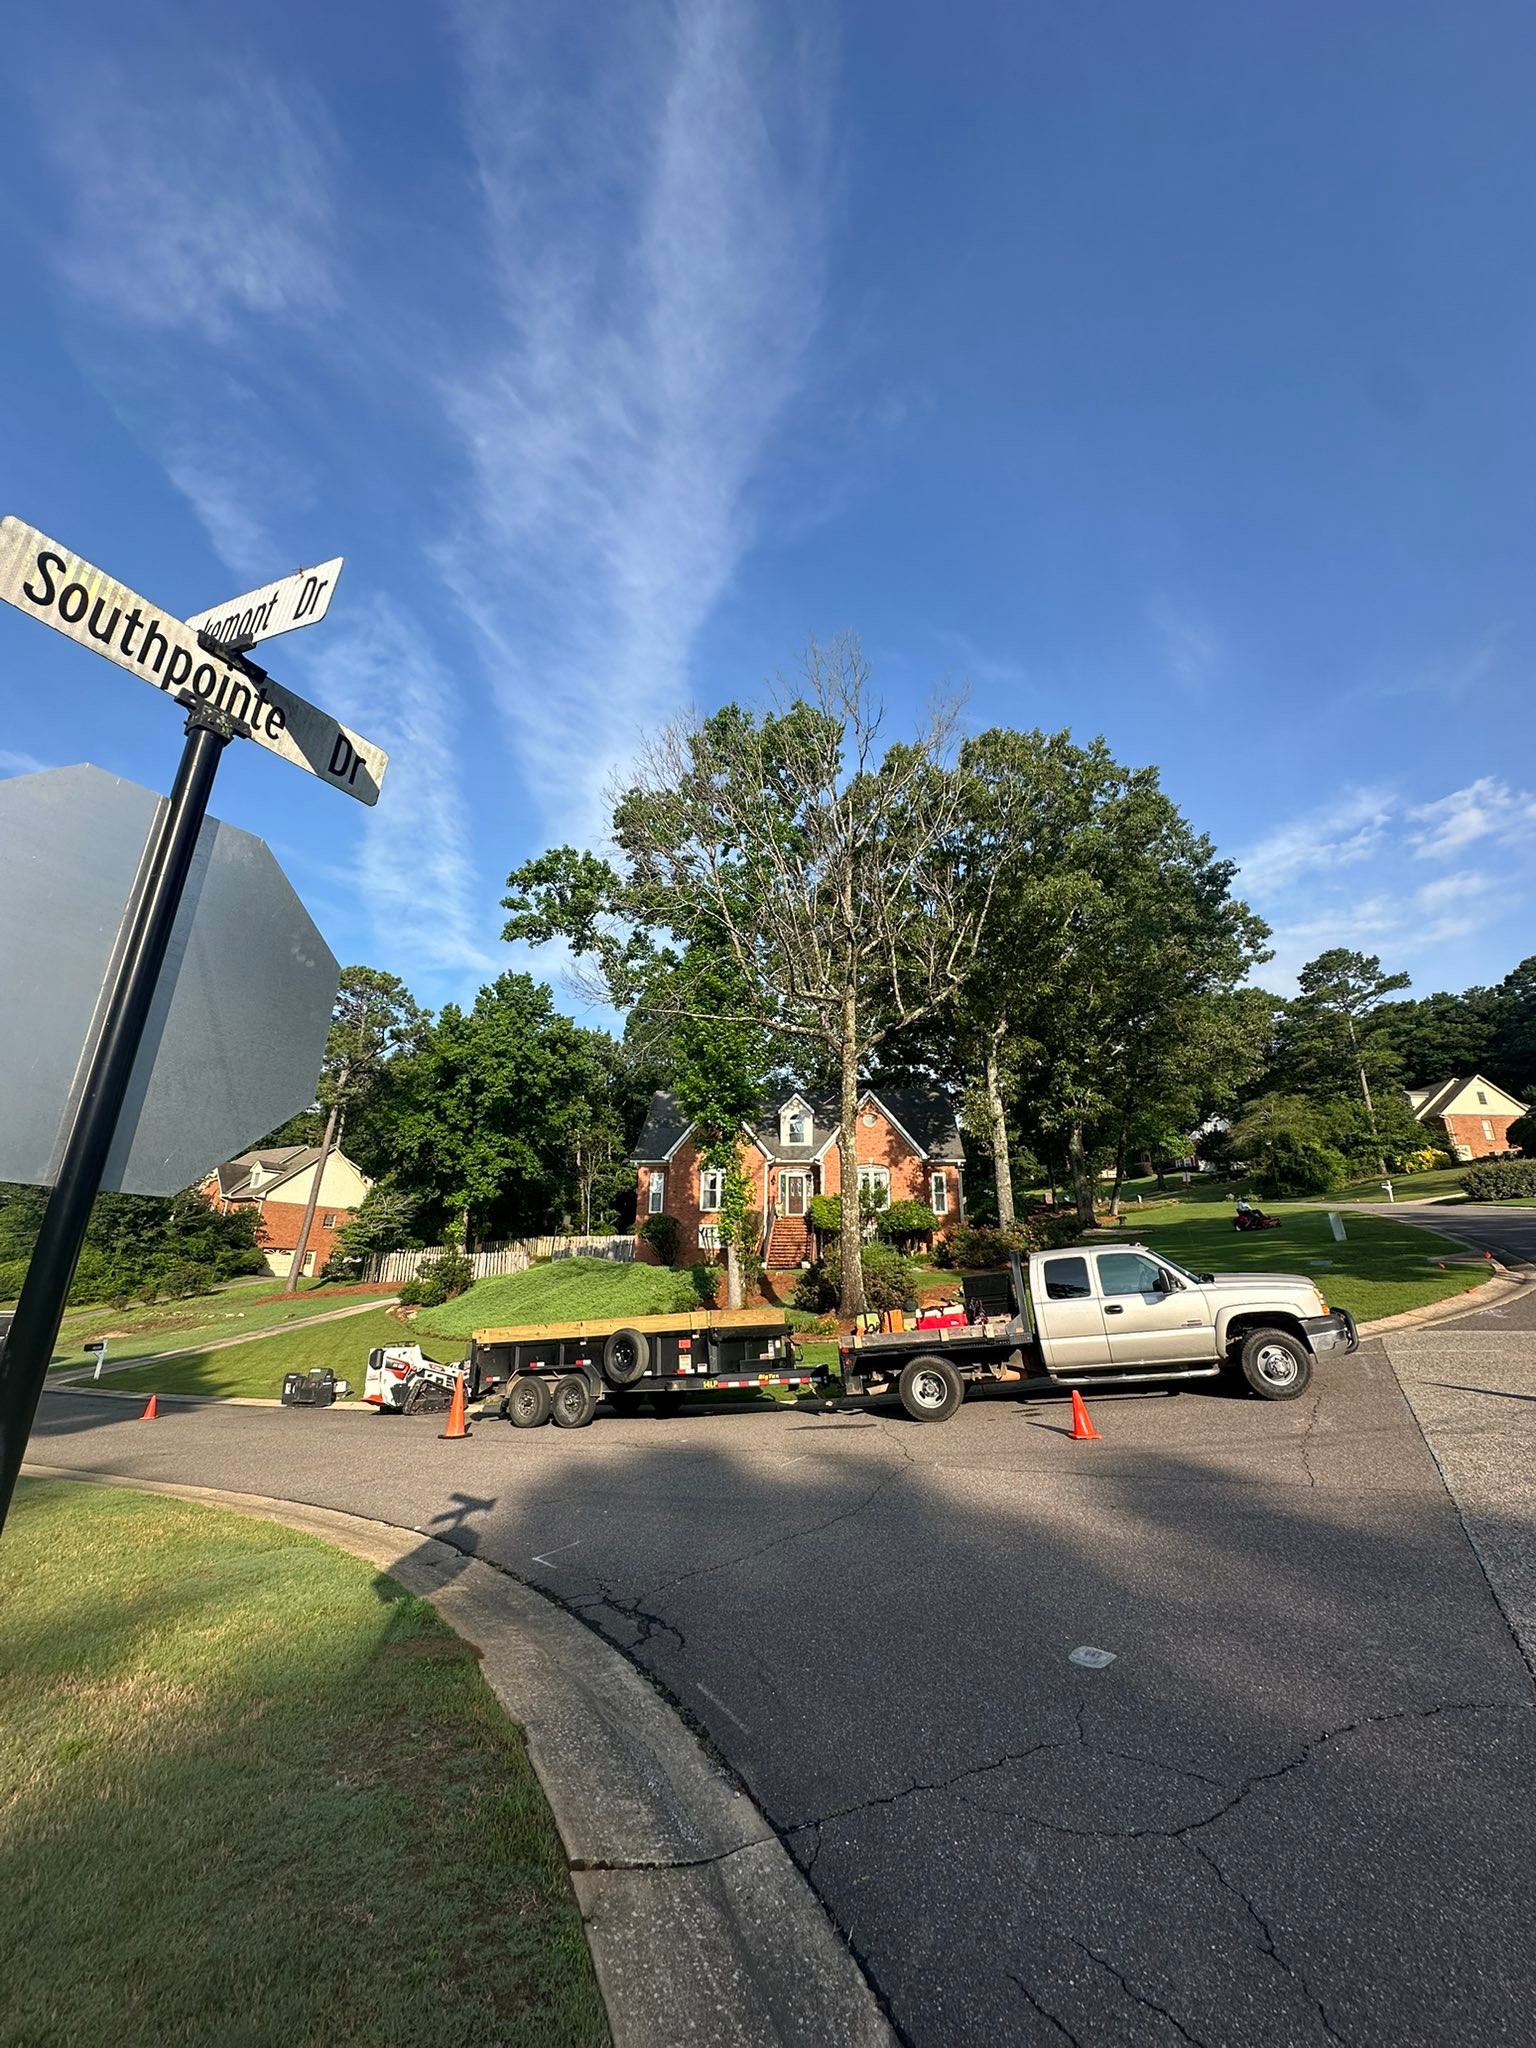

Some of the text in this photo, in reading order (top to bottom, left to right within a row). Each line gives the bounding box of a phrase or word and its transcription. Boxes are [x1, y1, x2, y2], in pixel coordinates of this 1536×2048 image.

[293, 576, 329, 620] Dr
[23, 551, 367, 785] Southpointe Dr
